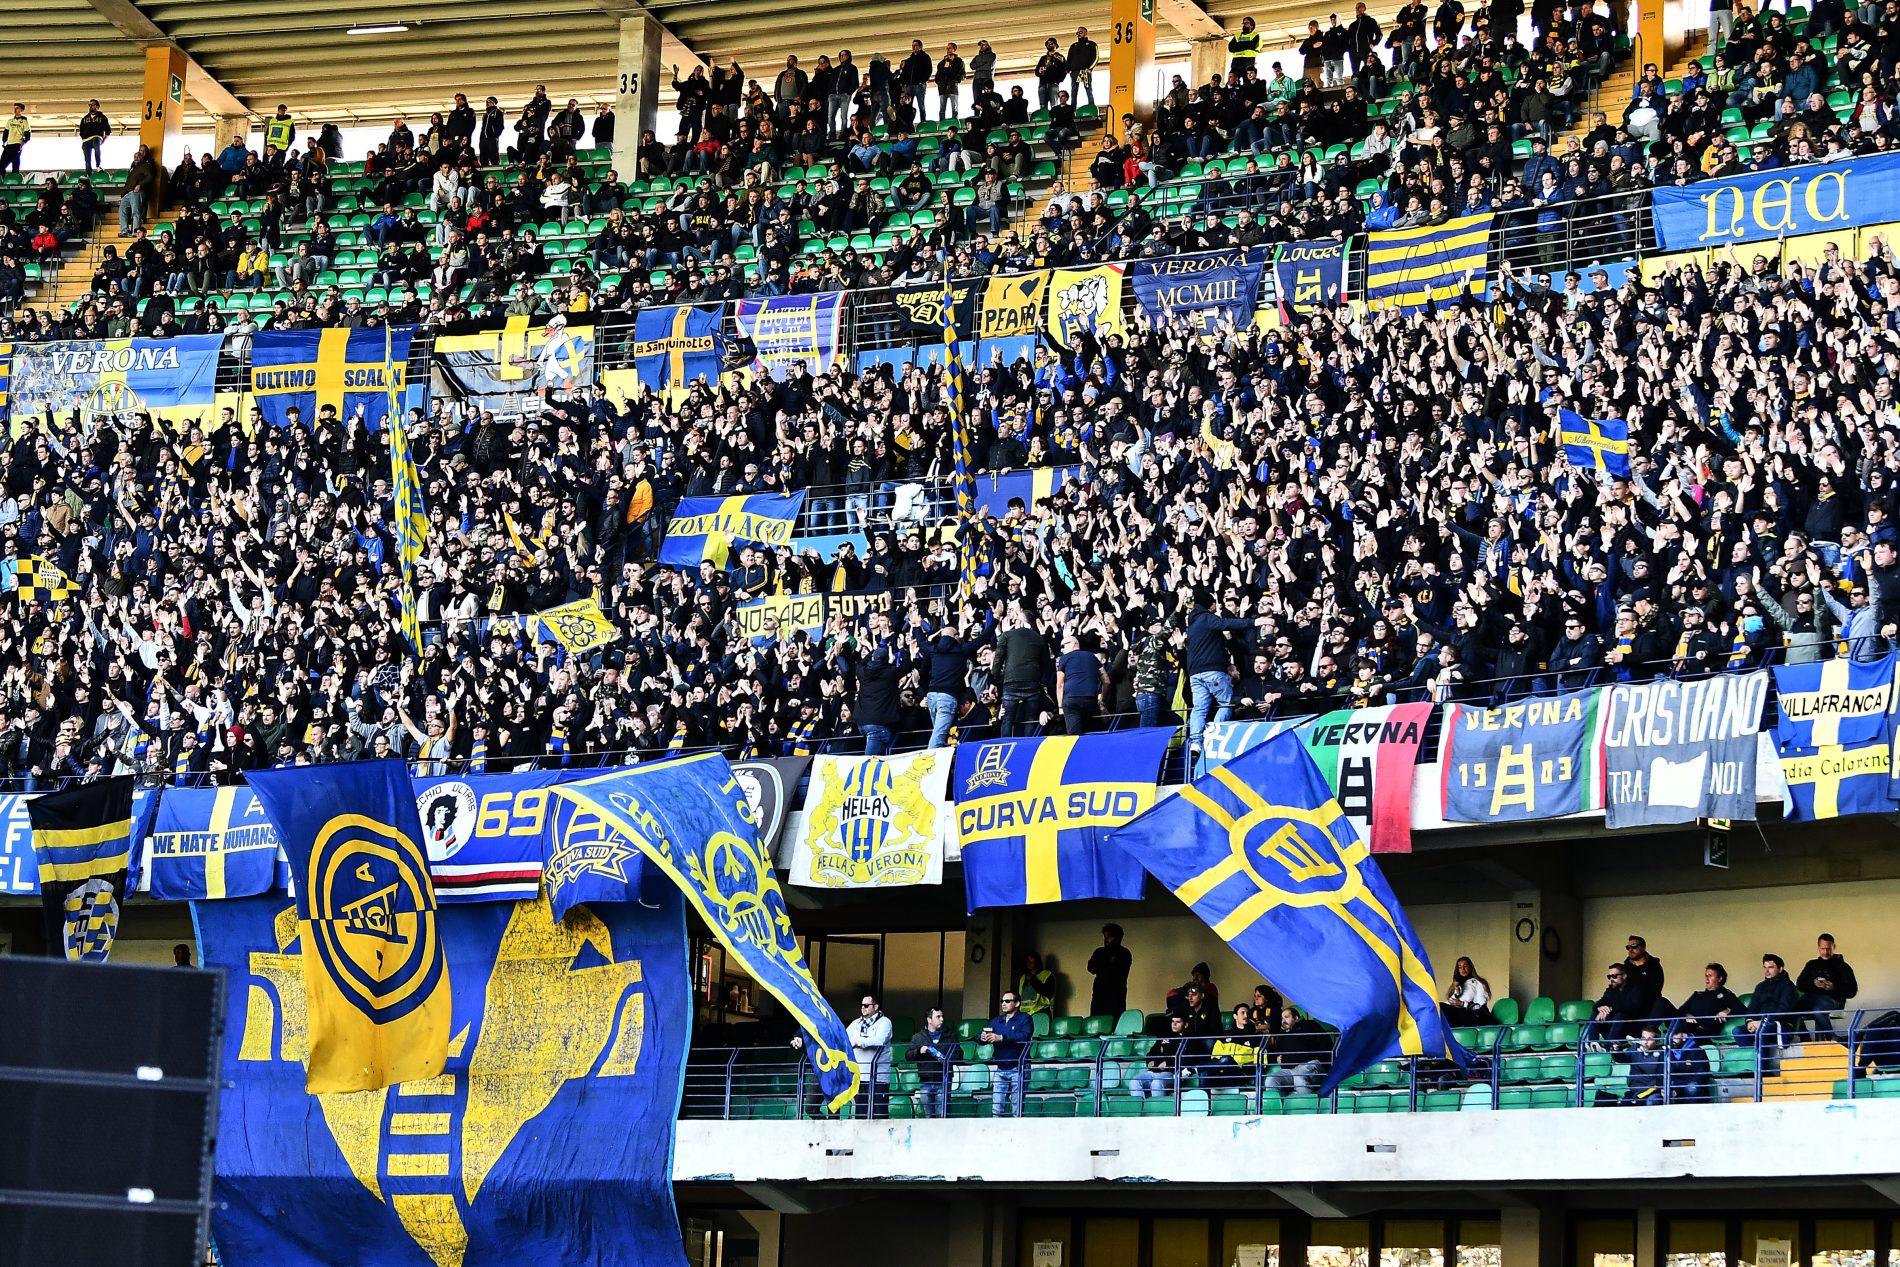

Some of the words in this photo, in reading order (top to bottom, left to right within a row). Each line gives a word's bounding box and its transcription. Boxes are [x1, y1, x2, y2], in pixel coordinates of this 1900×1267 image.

[1114, 22, 1134, 44] 36
[620, 73, 638, 94] 35
[145, 100, 163, 121] 34
[1151, 253, 1248, 277] VERONA
[895, 287, 969, 306] SUPERIRE
[1156, 279, 1237, 309] MCMIII
[51, 346, 181, 375] VERONA
[255, 369, 316, 390] ULTIMO
[344, 368, 402, 387] SCALN
[828, 594, 891, 617] SOTTO
[1466, 698, 1582, 731] VERONA
[1604, 671, 1769, 748] CRISTIANO
[1311, 722, 1418, 747] VERONA
[1609, 769, 1643, 805] TRA
[1709, 761, 1744, 795] NOI
[451, 783, 476, 812] ULTRAS
[842, 795, 891, 821] HELLAS
[475, 787, 550, 838] 69
[960, 796, 1058, 836] CURVA
[1067, 791, 1138, 819] SUD
[153, 834, 176, 854] WE
[180, 833, 220, 853] HATE
[223, 825, 279, 850] HUMANS
[584, 846, 610, 858] SUD
[817, 855, 855, 878] HELLAS
[866, 852, 925, 877] VERONA
